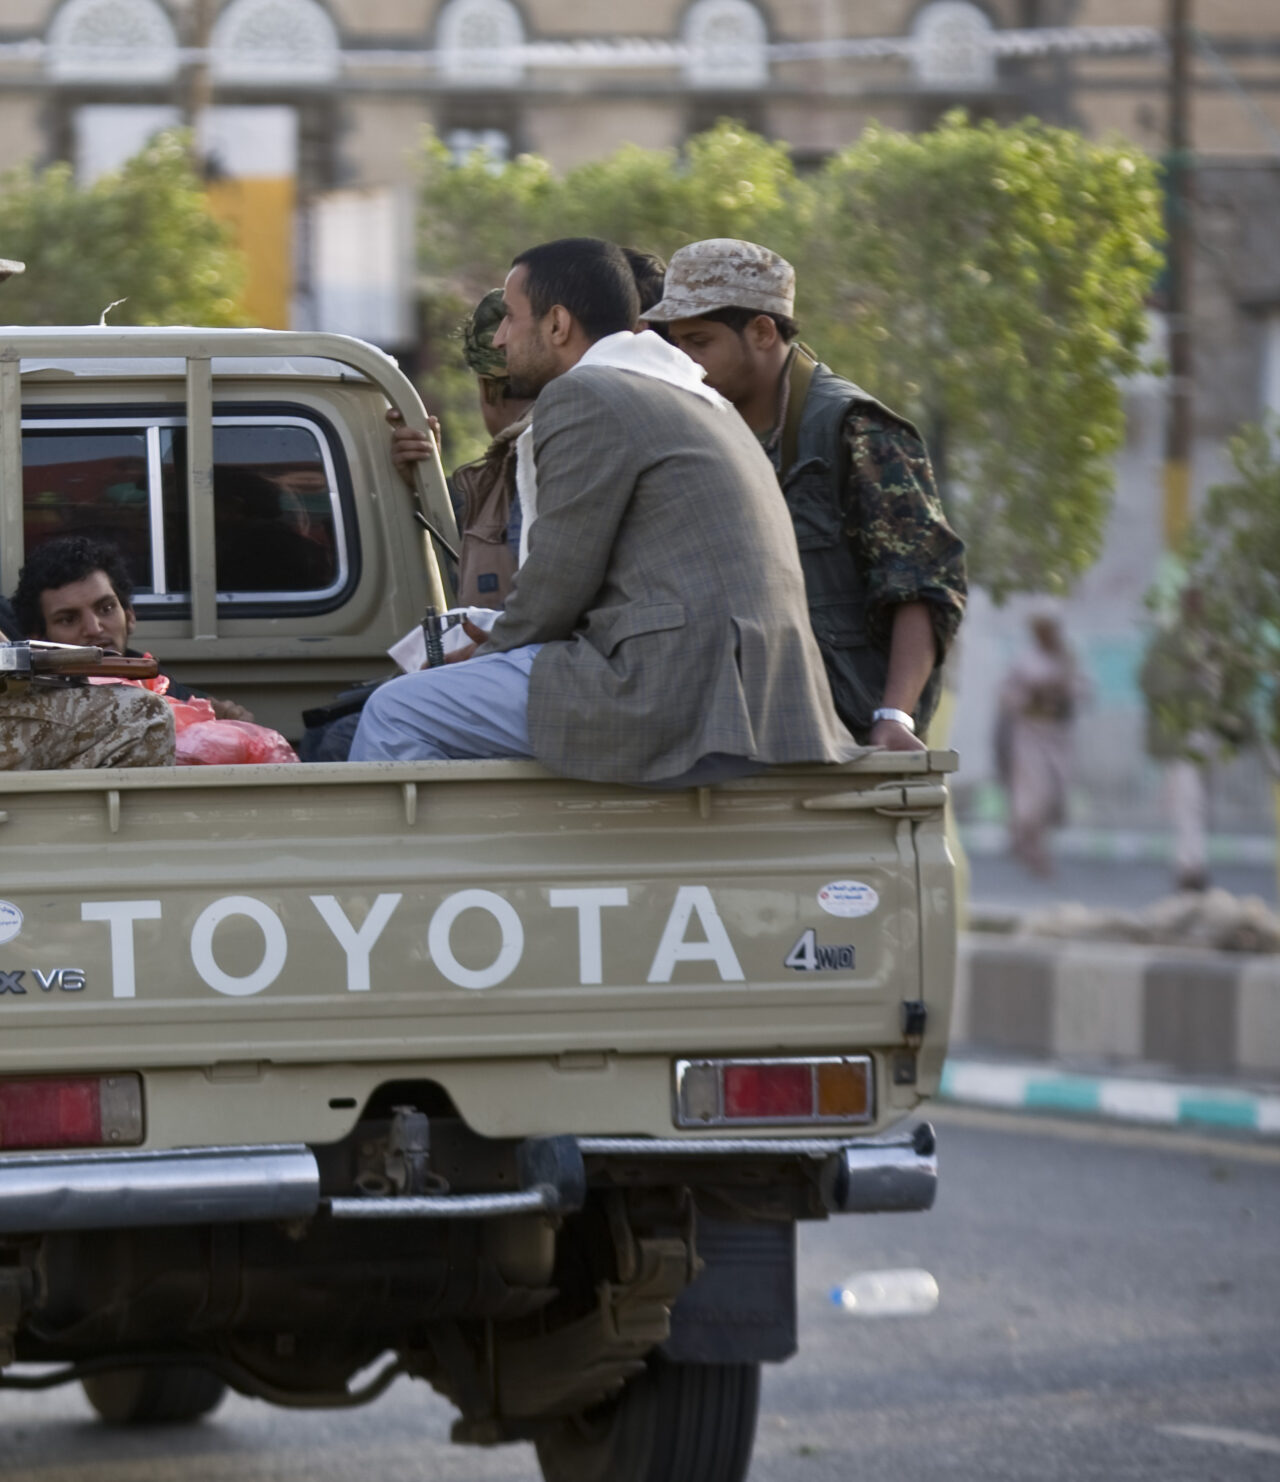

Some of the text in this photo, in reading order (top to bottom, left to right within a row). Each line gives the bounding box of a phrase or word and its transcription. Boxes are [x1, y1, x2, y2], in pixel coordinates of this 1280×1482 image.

[82, 886, 745, 998] TOYOTA
[784, 927, 855, 972] 4WD
[31, 968, 86, 993] V6
